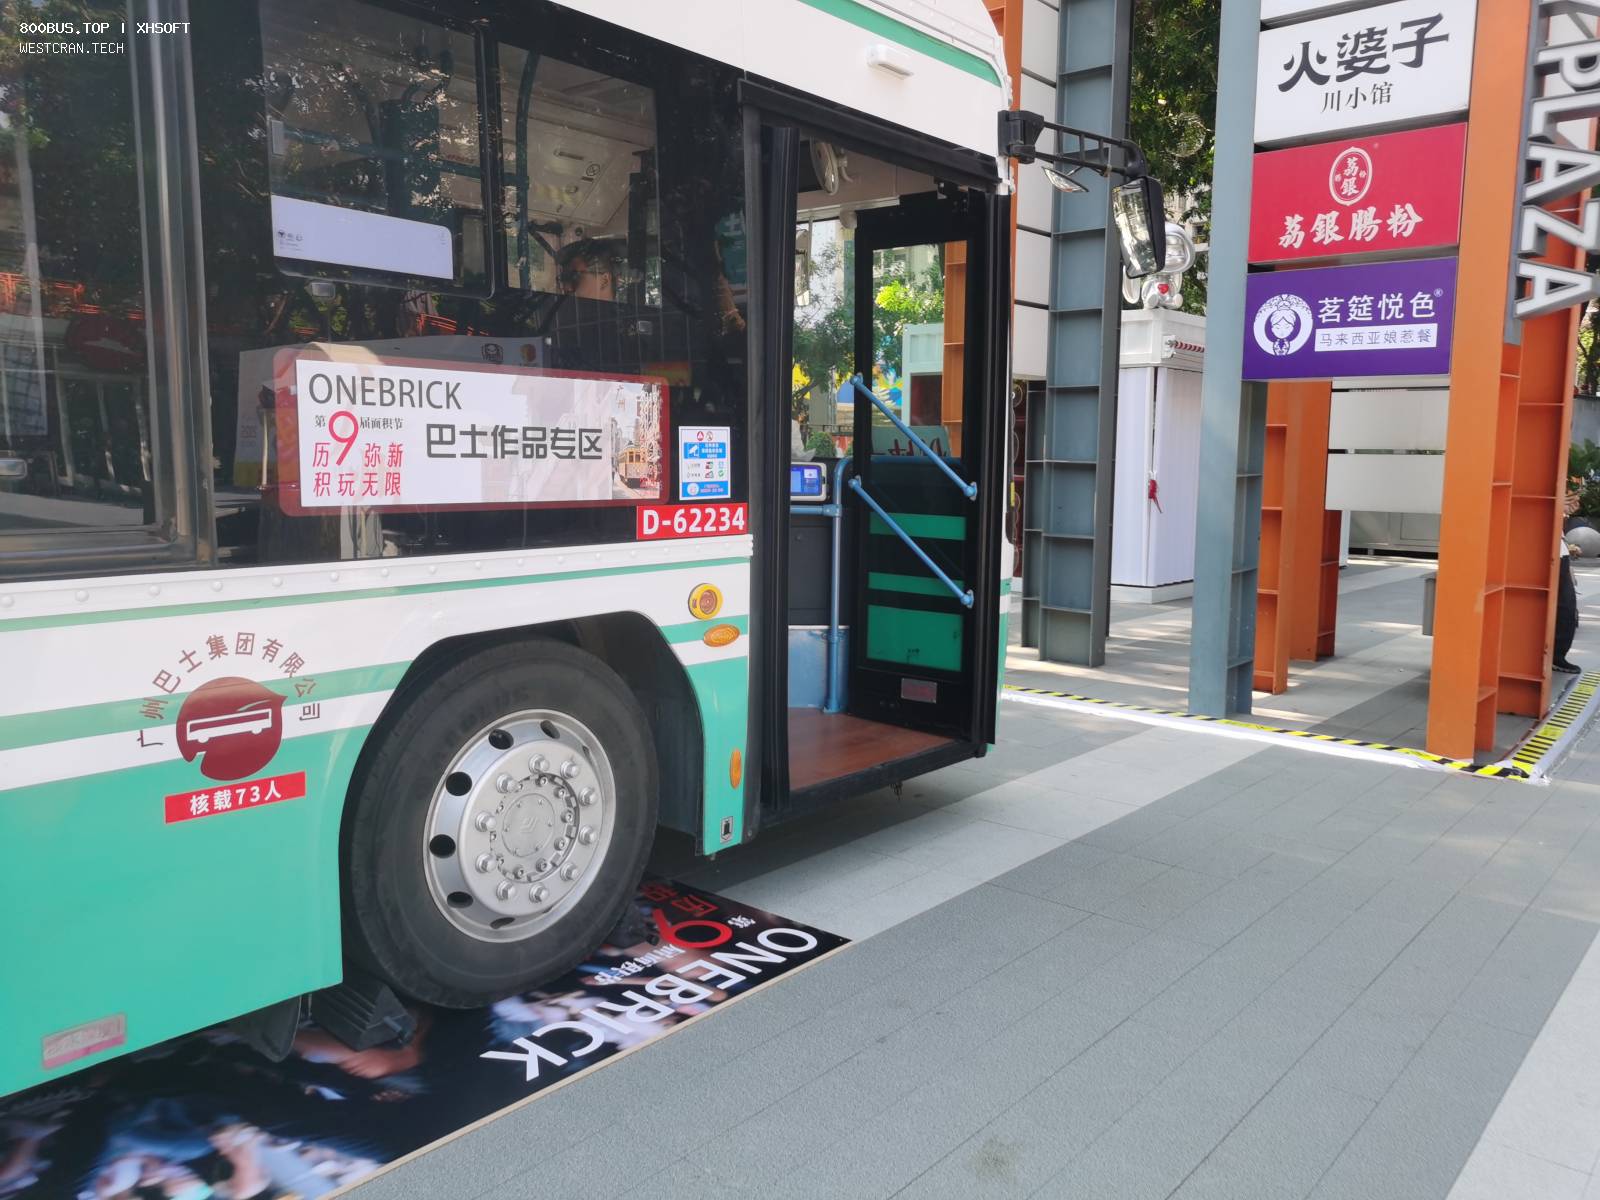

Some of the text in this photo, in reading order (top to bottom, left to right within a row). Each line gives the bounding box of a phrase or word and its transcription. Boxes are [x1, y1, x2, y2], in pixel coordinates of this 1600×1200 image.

[1278, 12, 1449, 93] 火婆子
[1321, 81, 1394, 113] 川小馆
[1514, 39, 1600, 318] PLAZA
[1319, 327, 1432, 347] 马来西亚娘惹餐
[308, 373, 462, 410] ONEBRICK
[426, 423, 602, 460] 巴士作品专区
[312, 471, 401, 497] 积玩无限
[643, 506, 745, 535] D-62234
[137, 632, 321, 748] 广州巴士集团有限公司
[189, 780, 282, 816] 核载73人
[479, 926, 818, 1082] ONEBRICK
